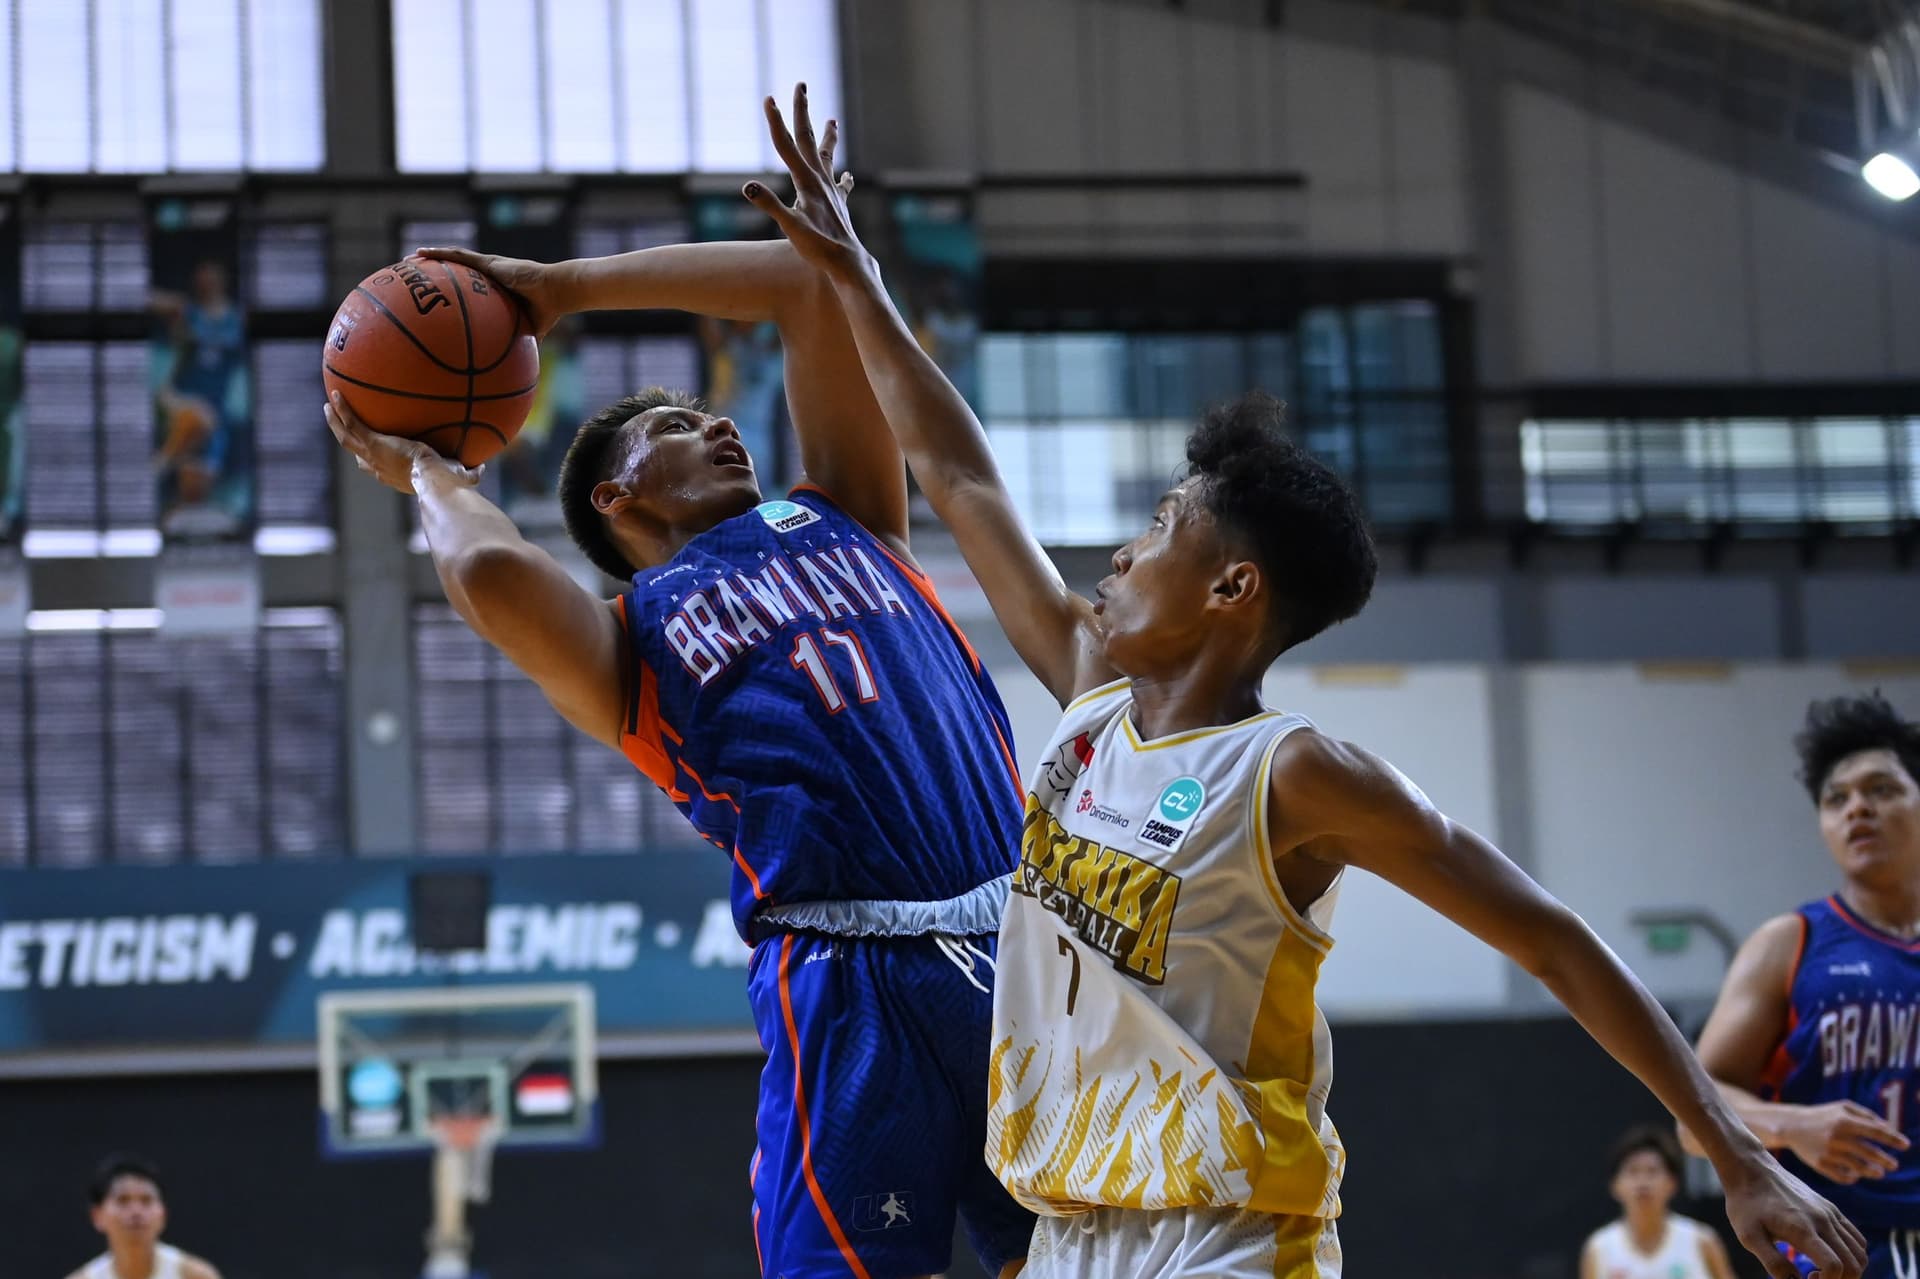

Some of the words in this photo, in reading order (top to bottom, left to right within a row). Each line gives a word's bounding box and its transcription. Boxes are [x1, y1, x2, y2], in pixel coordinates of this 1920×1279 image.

[775, 511, 809, 528] CAMPUS
[780, 516, 811, 531] LEAGUE
[789, 626, 880, 715] 17
[1163, 791, 1189, 812] CL
[1089, 805, 1130, 828] Dinamika
[1140, 829, 1176, 847] LEAGUE
[1145, 819, 1183, 839] CAMPUS
[311, 903, 641, 978] ACEMIC
[1057, 934, 1081, 1017] 7
